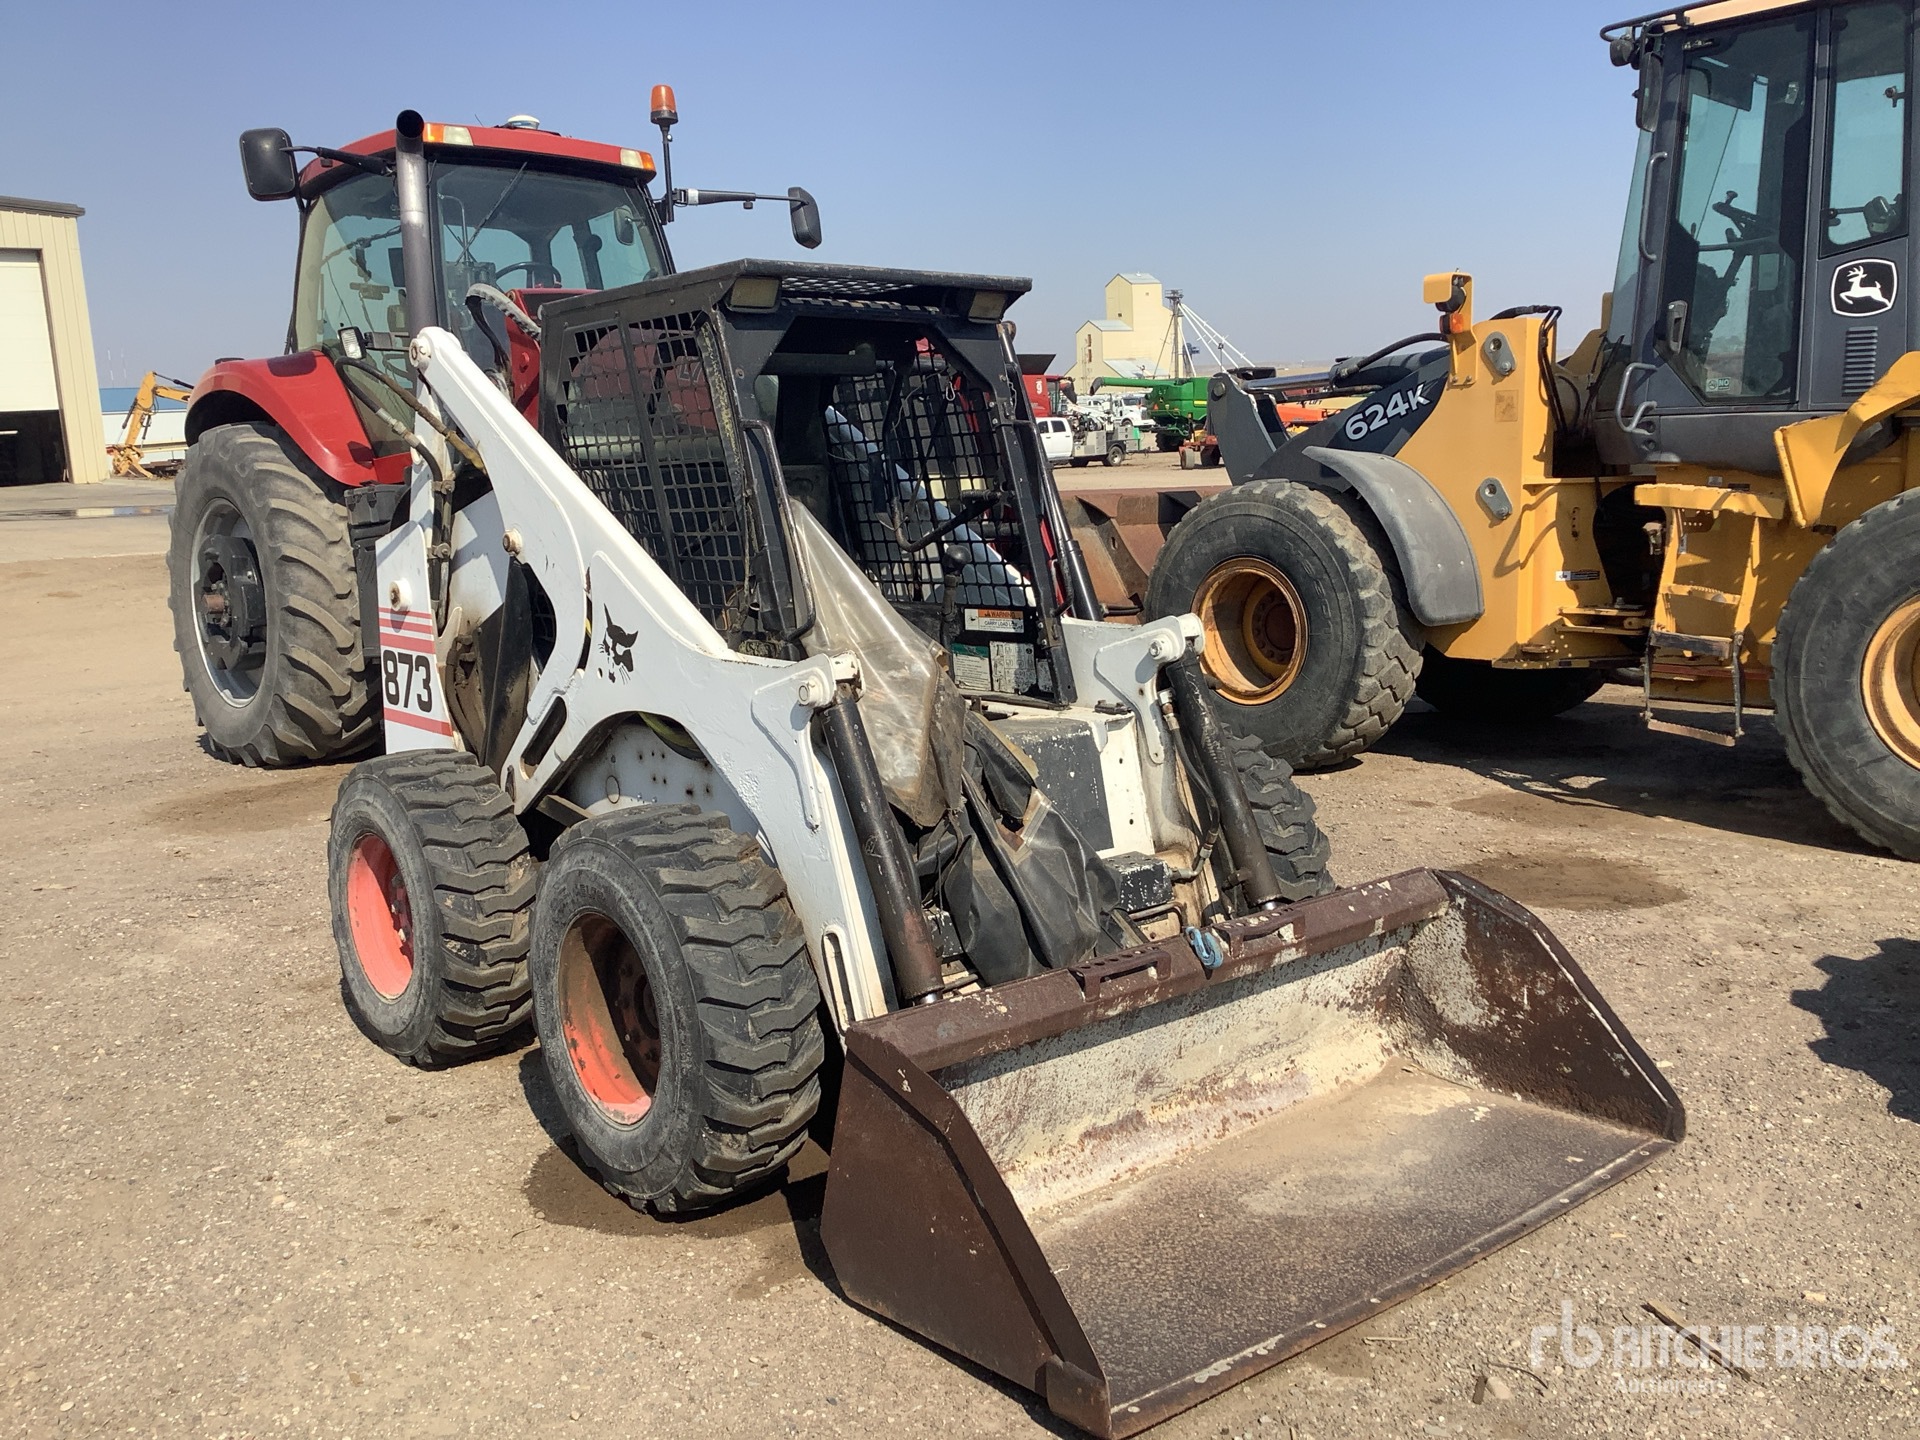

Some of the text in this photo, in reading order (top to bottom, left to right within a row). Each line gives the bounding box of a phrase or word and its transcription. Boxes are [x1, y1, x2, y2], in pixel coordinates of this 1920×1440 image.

[1345, 383, 1430, 441] 624K
[990, 611, 1016, 619] WARNING
[382, 649, 433, 713] 873
